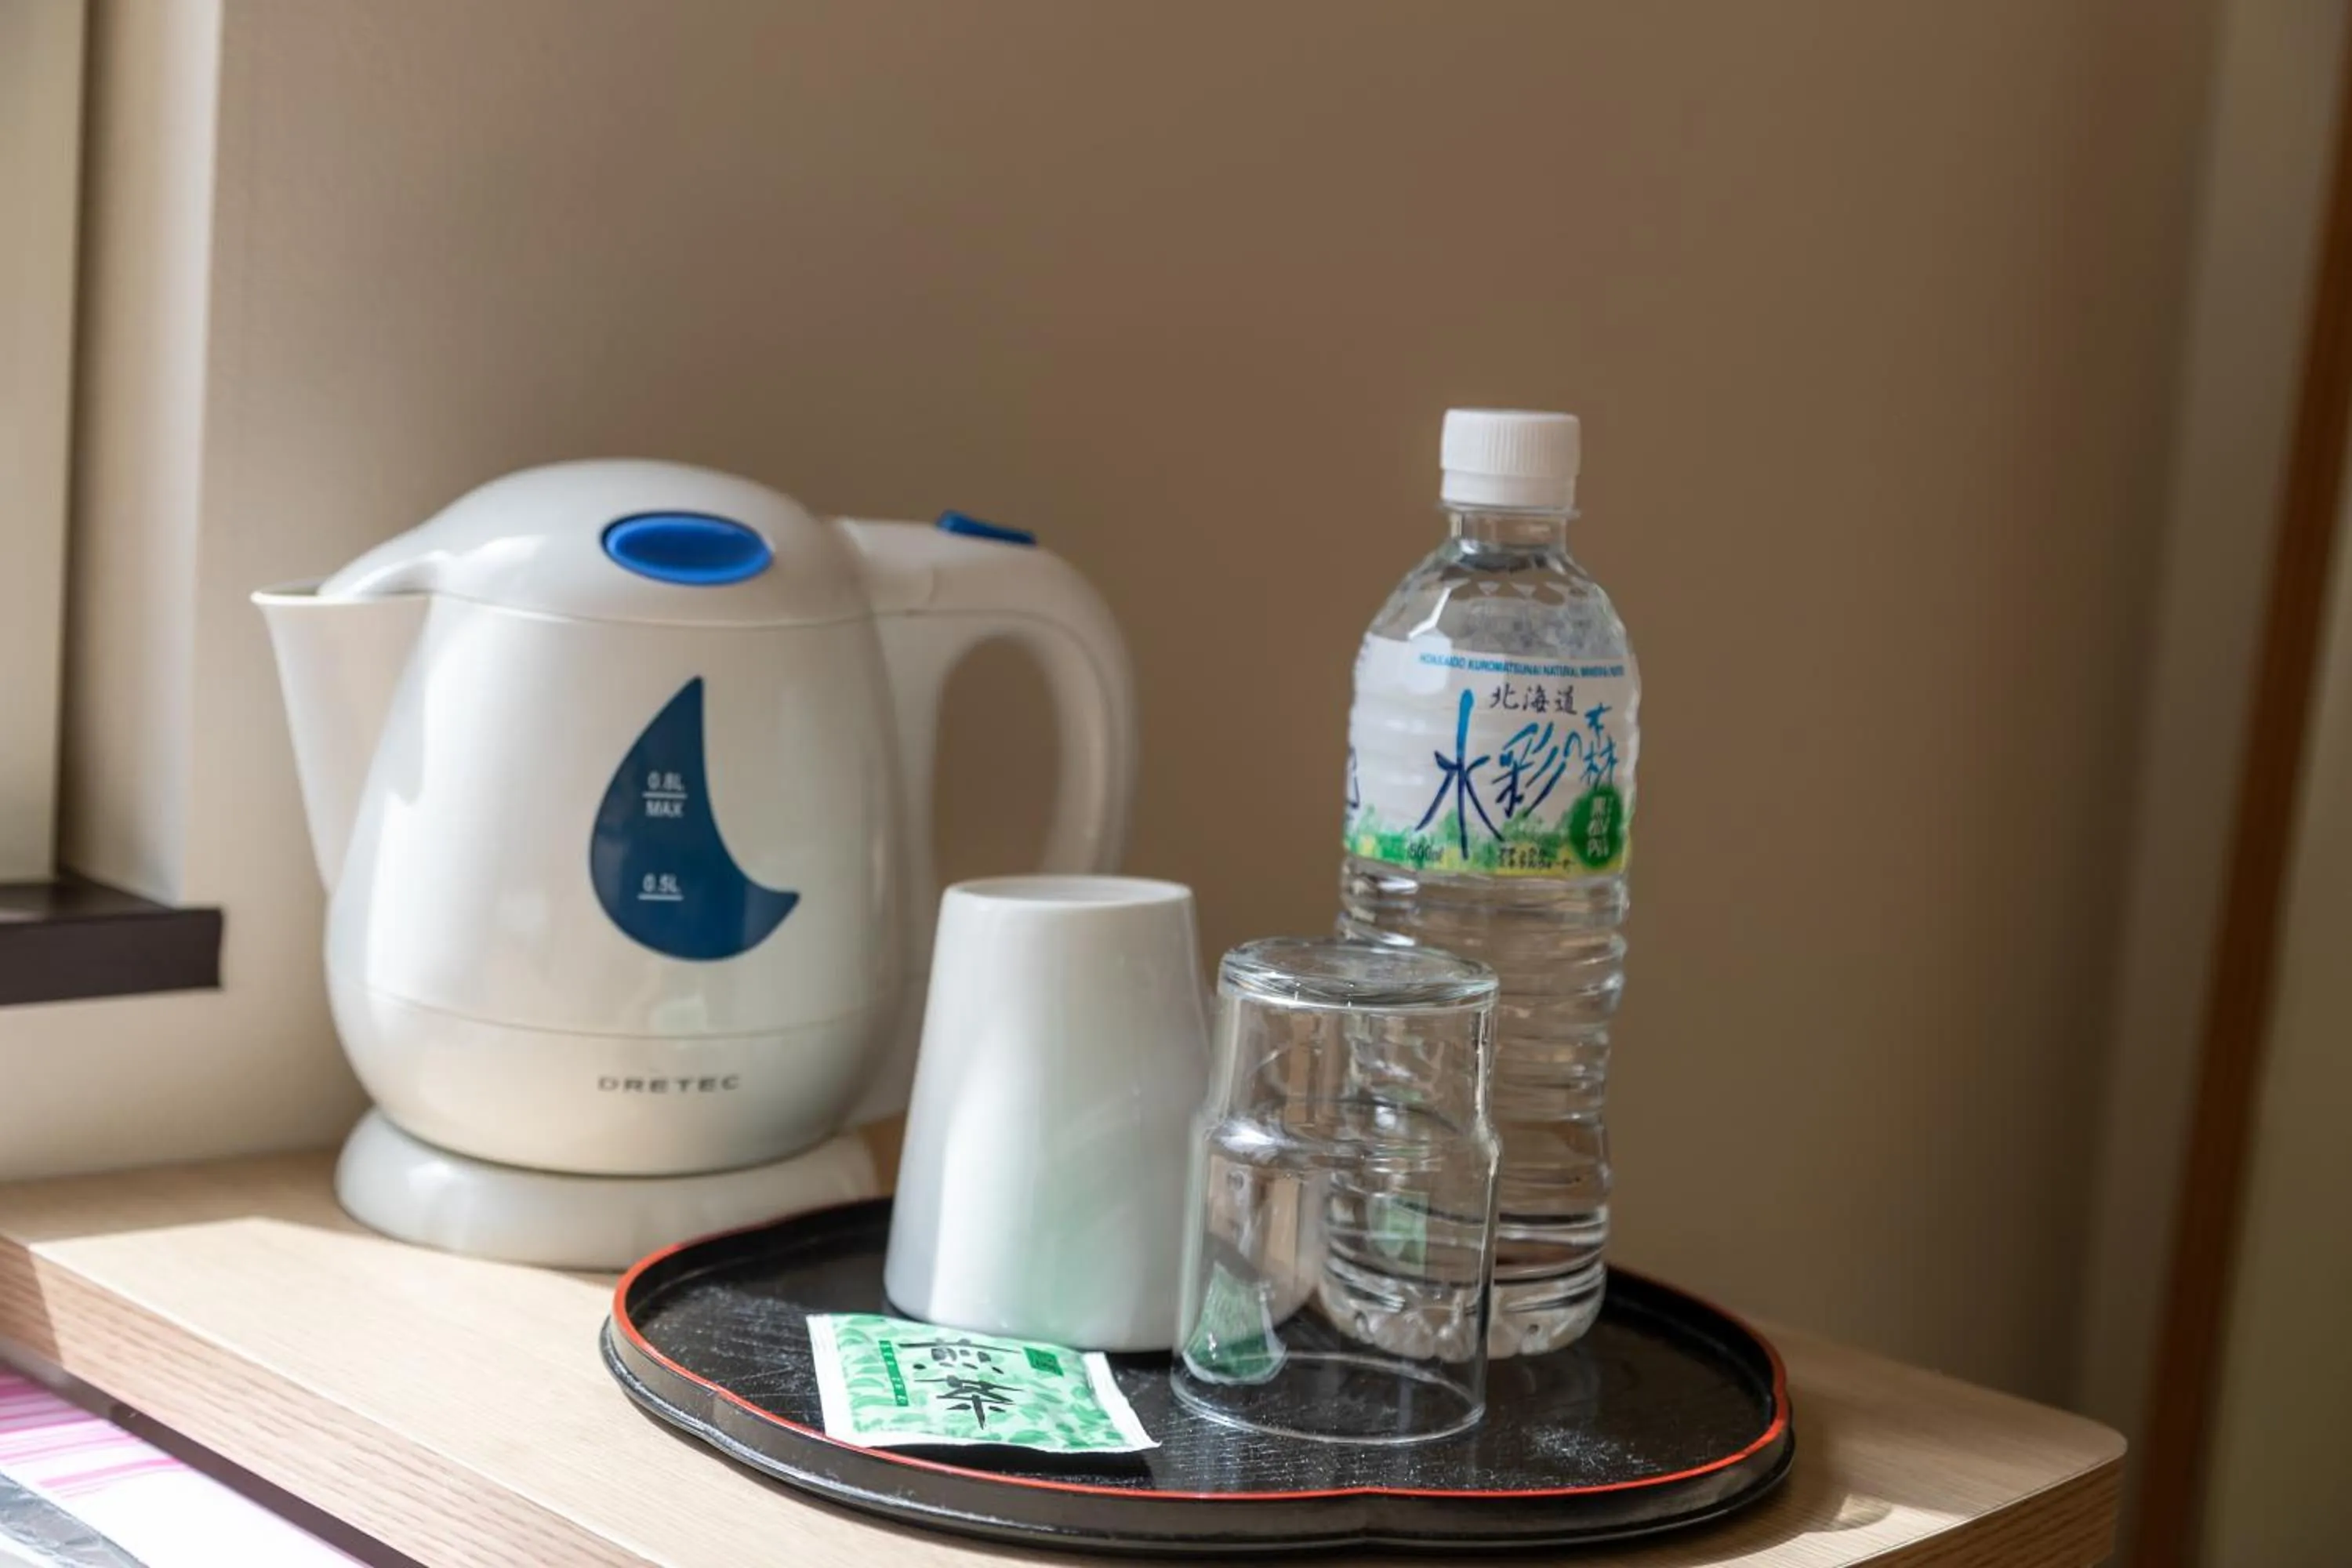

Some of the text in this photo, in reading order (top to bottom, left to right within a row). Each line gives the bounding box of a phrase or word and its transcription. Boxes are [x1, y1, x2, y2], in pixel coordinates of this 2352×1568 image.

[1491, 682, 1577, 715] 北海道
[645, 800, 683, 817] MAX
[597, 1073, 742, 1094] DRETEC
[898, 1337, 1022, 1430] 煎茶
